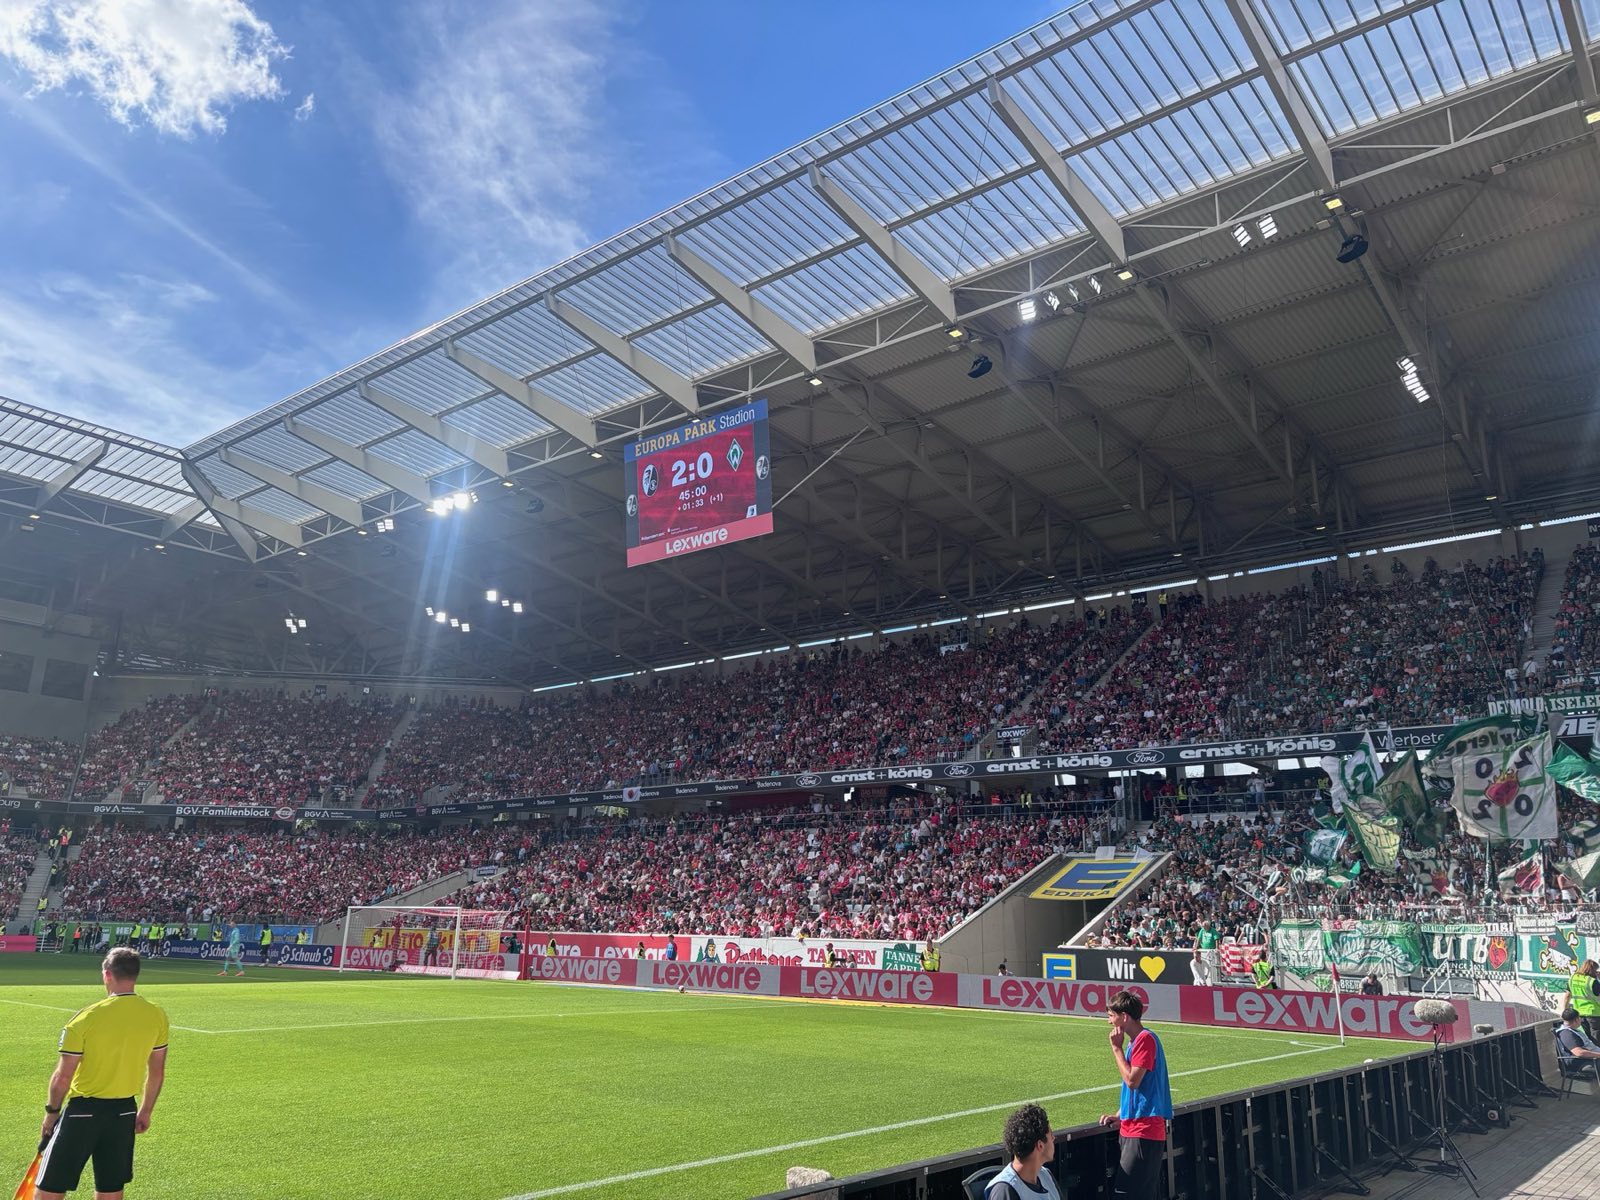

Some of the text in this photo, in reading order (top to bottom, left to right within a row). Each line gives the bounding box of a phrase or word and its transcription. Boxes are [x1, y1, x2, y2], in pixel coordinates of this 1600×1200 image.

[635, 408, 755, 457] EUROPA PARK Stadion
[671, 451, 713, 488] 2:0
[679, 485, 707, 501] 45:00
[665, 527, 728, 555] Lexware
[1179, 743, 1244, 760] ernst
[1266, 736, 1336, 753] könig
[986, 758, 1040, 773] ernst
[1057, 753, 1113, 769] könig
[1133, 752, 1157, 764] Ford
[830, 770, 875, 783] ernst
[888, 766, 933, 780] könig
[948, 765, 969, 776] Ford
[93, 805, 111, 813] BGV
[175, 806, 271, 818] BGV-Familienblock
[304, 810, 321, 818] BGV
[1041, 887, 1113, 899] EDEKA
[385, 932, 424, 950] LTTO
[1433, 933, 1489, 964] UTB
[290, 948, 321, 963] Schaub
[345, 948, 408, 968] Lexwae
[595, 946, 678, 961] Lexwar
[885, 950, 921, 964] TANNE
[531, 957, 621, 982] Lexware
[652, 962, 762, 991] Lexware
[1106, 957, 1136, 980] Wir
[800, 969, 934, 1001] Lexware
[1213, 990, 1433, 1037] Lexware
